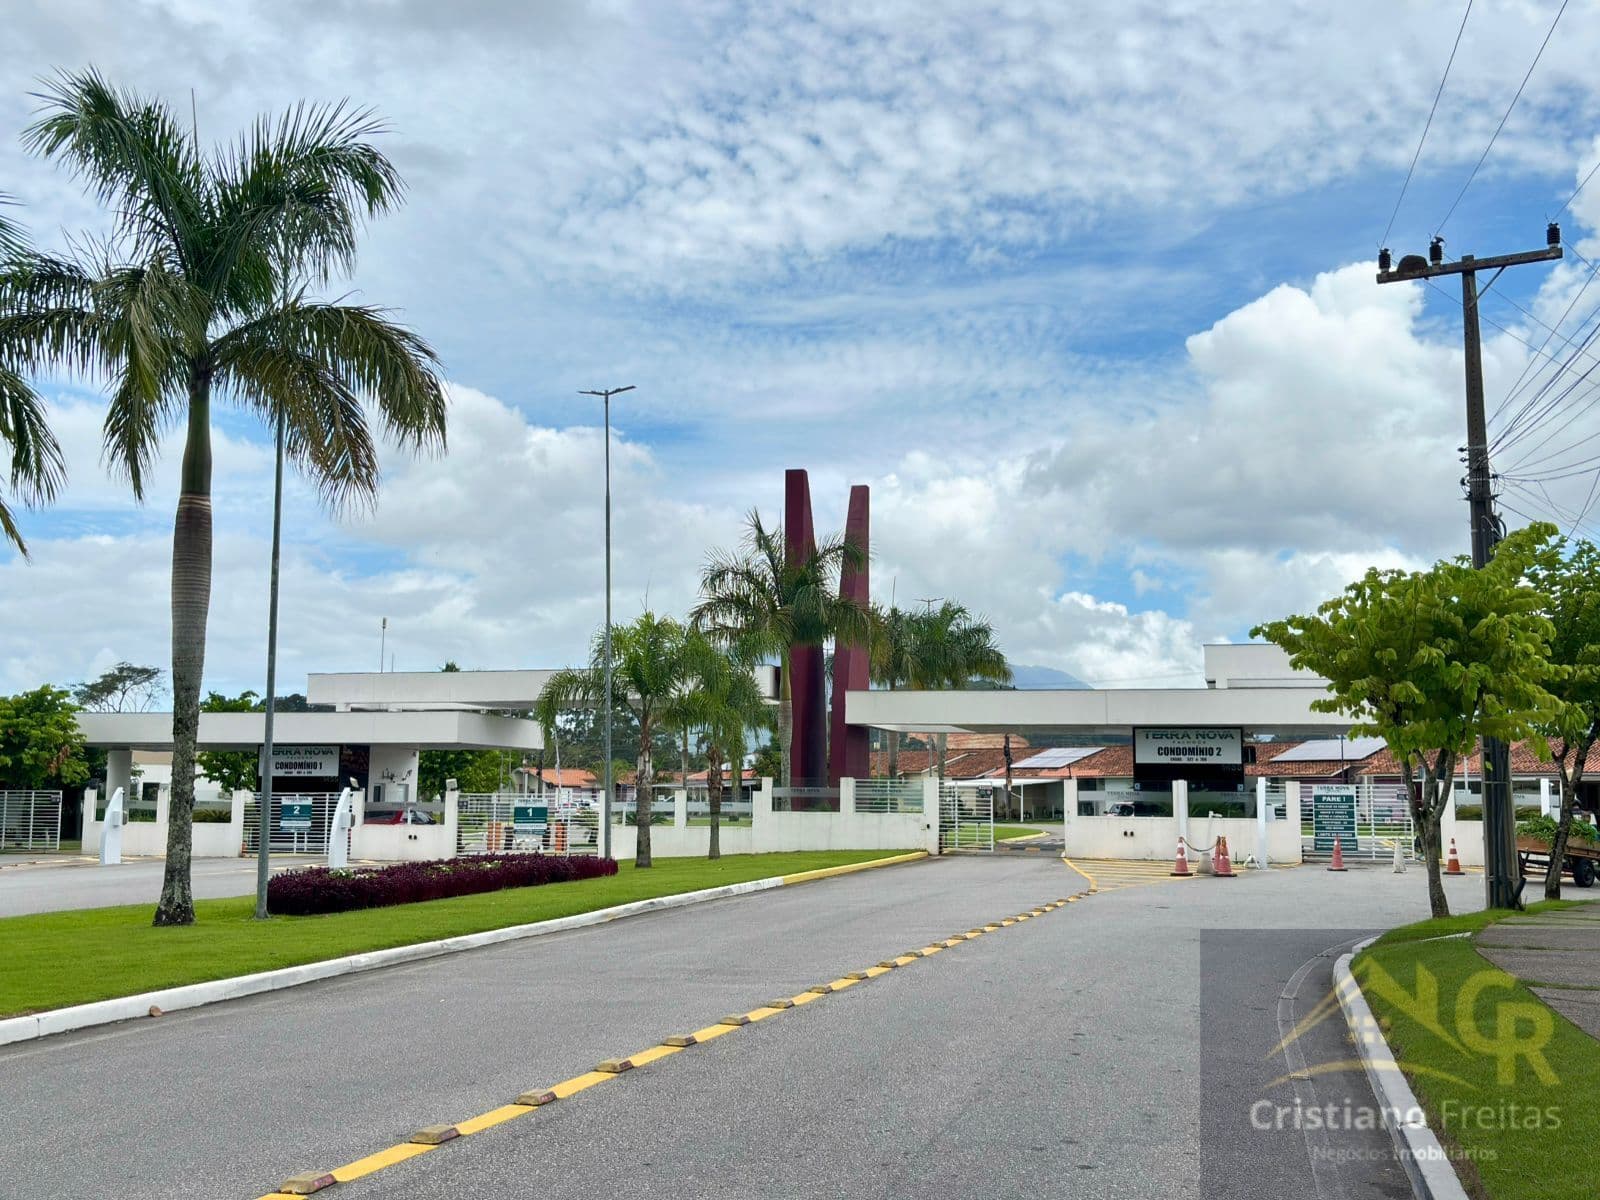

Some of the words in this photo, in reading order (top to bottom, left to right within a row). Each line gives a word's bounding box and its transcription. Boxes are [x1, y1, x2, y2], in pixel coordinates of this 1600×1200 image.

[1144, 730, 1191, 740] TERRA
[1195, 730, 1235, 740] NOVA
[304, 747, 334, 756] NOVA
[1157, 745, 1214, 757] CONDOMÍNIO
[1216, 747, 1222, 757] 2
[275, 760, 318, 770] CONDOMÍNIO
[319, 761, 323, 770] 1
[293, 805, 300, 815] 2
[526, 807, 533, 817] 1
